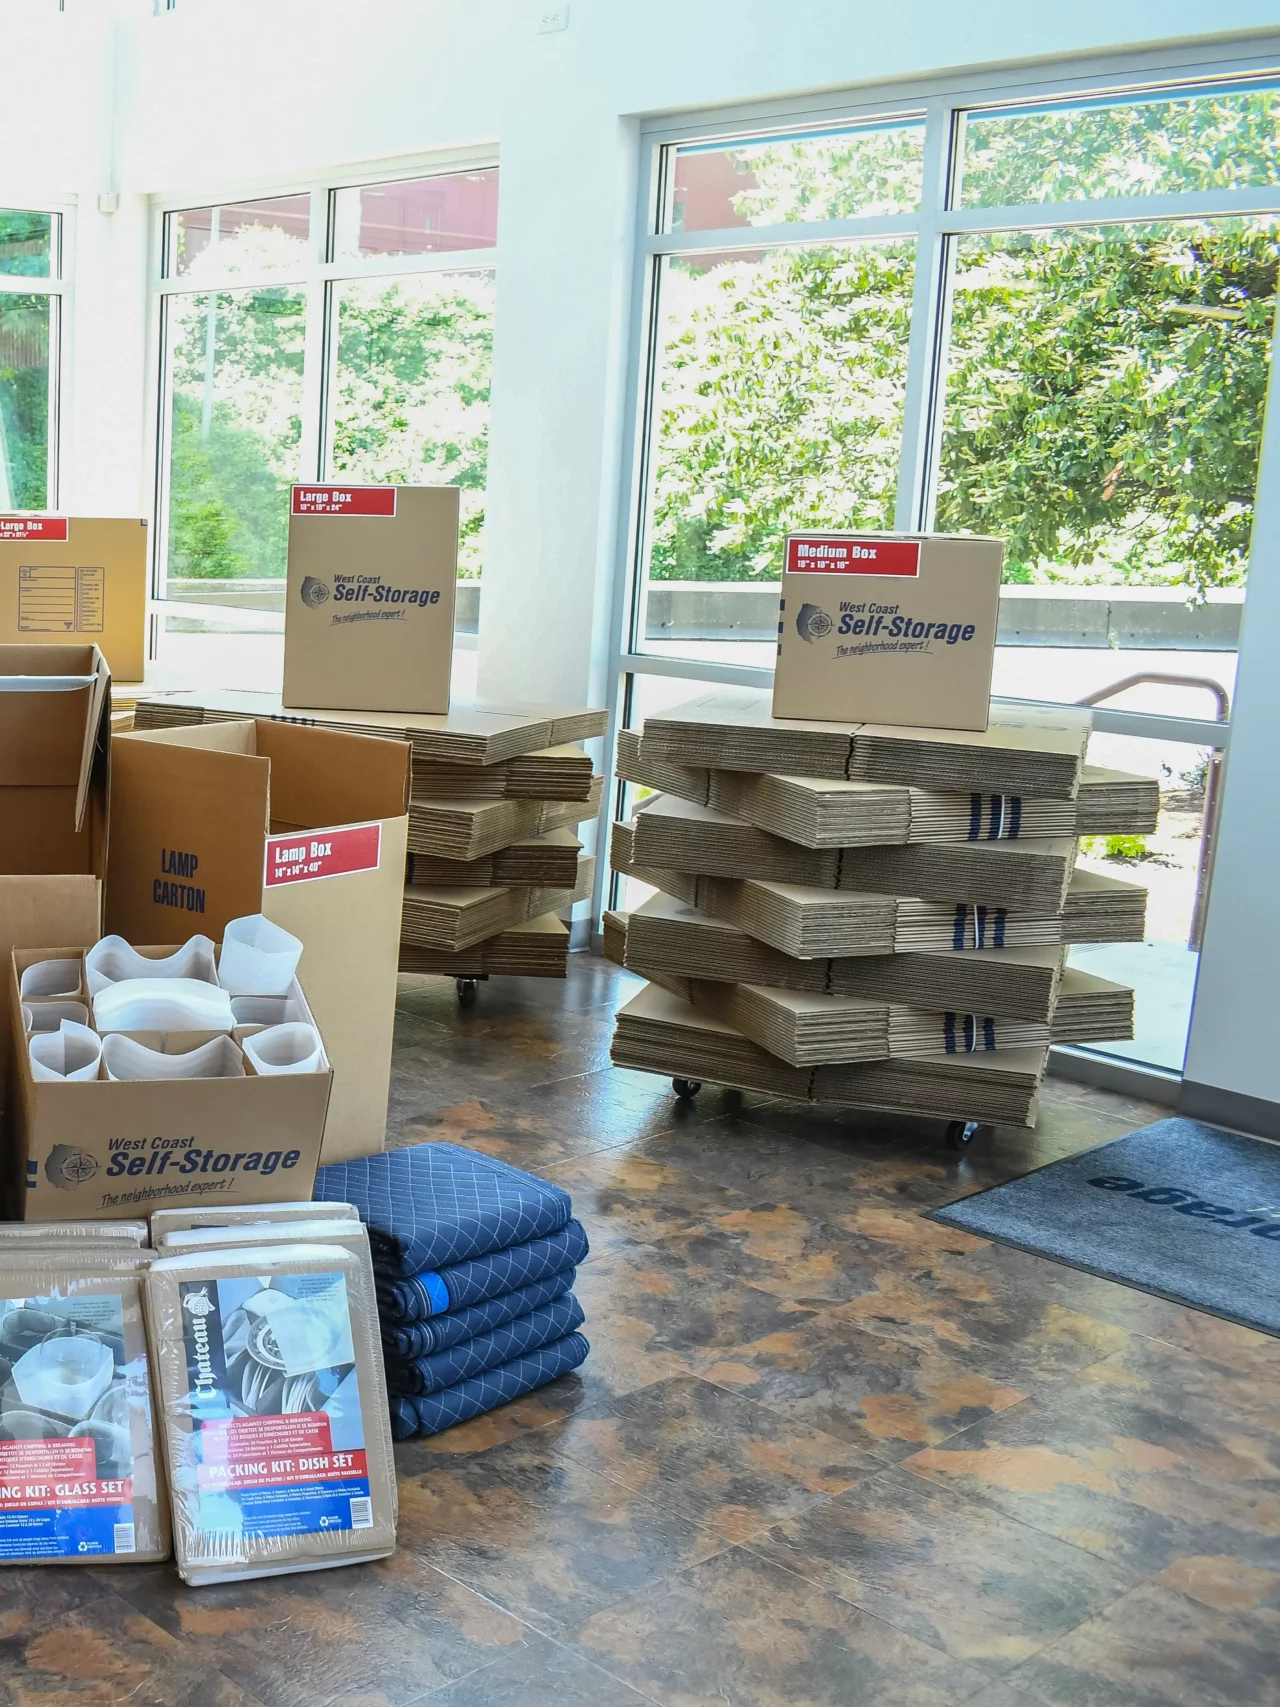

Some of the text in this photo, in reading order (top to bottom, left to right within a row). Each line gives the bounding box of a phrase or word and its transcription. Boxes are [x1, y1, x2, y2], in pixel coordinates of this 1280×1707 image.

[300, 491, 352, 503] Large Box
[27, 521, 43, 530] Box
[798, 544, 877, 559] Medium Box
[334, 574, 381, 584] West Coast
[333, 584, 440, 607] Self-Storage
[332, 615, 341, 623] The
[343, 610, 380, 623] neighborhood
[840, 602, 899, 614] West Coast
[838, 614, 975, 645] Self-Storage
[837, 645, 848, 656] The
[850, 640, 898, 655] neighborhood
[275, 842, 332, 863] Lamp Box
[161, 848, 198, 878] LAMP
[153, 879, 205, 913] CARTON
[108, 1136, 195, 1150] West Coast
[106, 1149, 301, 1177] Self-Storage
[101, 1194, 119, 1206] The
[120, 1181, 191, 1202] neighborhood
[194, 1315, 218, 1400] Chateau
[210, 1454, 353, 1479] PACKING KIT: DISH SET
[25, 1485, 51, 1498] KIT:
[55, 1483, 96, 1496] GLASS
[101, 1481, 124, 1493] SET
